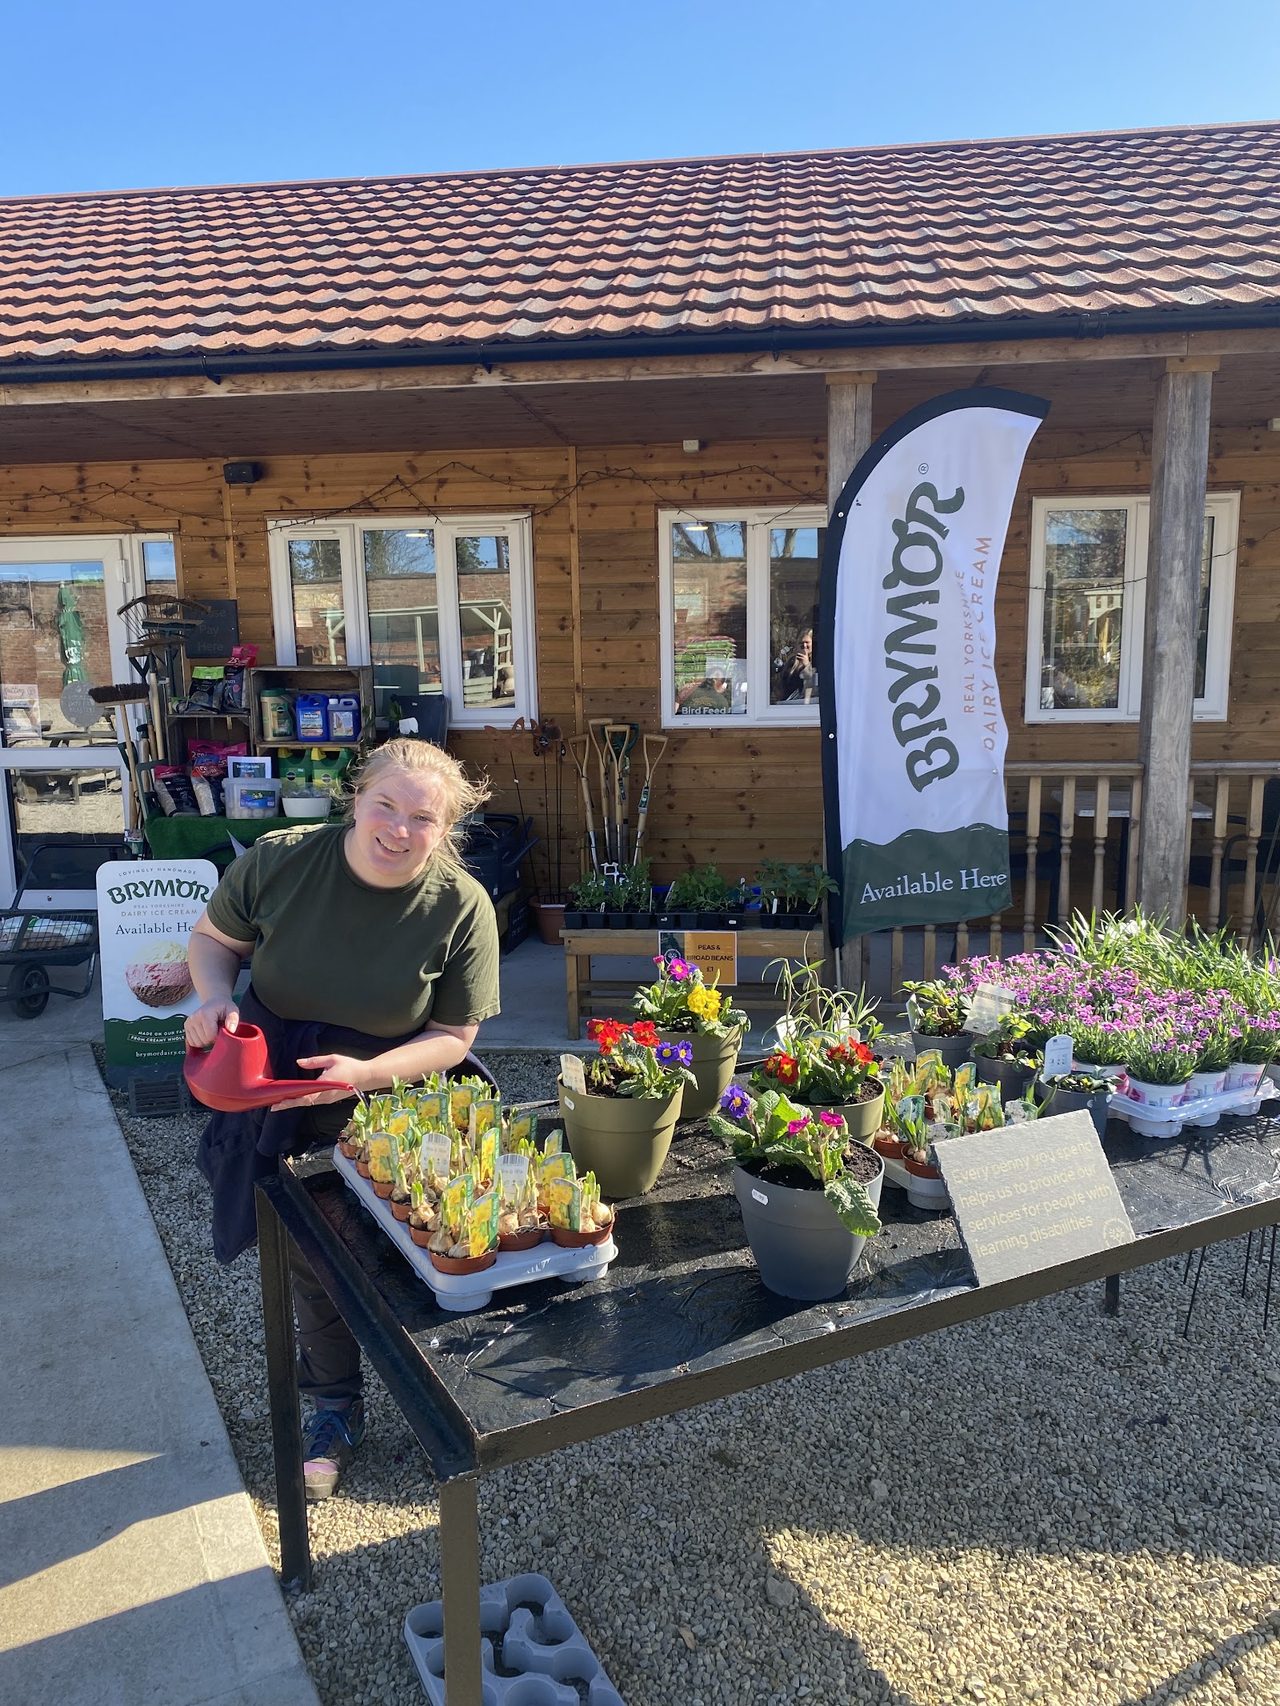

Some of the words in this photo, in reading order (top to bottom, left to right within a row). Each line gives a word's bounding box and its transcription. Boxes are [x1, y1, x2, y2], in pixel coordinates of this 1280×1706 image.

[881, 480, 966, 793] BRYMOR
[681, 706, 701, 715] Bird
[703, 706, 727, 715] Feed
[963, 673, 975, 713] REAL
[981, 680, 998, 751] DAIRY
[118, 868, 153, 877] LOVINGLY
[157, 867, 197, 875] HANDMADE
[860, 871, 954, 904] Available
[960, 868, 1007, 890] Here
[106, 878, 210, 904] BRYMOR
[115, 923, 172, 935] Available
[177, 921, 195, 933] He
[121, 910, 148, 918] DAIRY
[168, 908, 198, 916] CREAM
[952, 1165, 990, 1184] Every
[991, 1155, 1030, 1175] penny
[1033, 1150, 1056, 1165] you
[959, 1191, 997, 1209] helps
[999, 1186, 1013, 1198] us
[1015, 1182, 1028, 1194] to
[1030, 1168, 1074, 1191] provide
[1078, 1164, 1098, 1178] our
[967, 1211, 1021, 1233] services
[1023, 1203, 1041, 1217] for
[1044, 1193, 1086, 1214] people
[1088, 1182, 1113, 1200] with
[974, 1231, 1029, 1257] learning
[1031, 1214, 1093, 1240] disabilities
